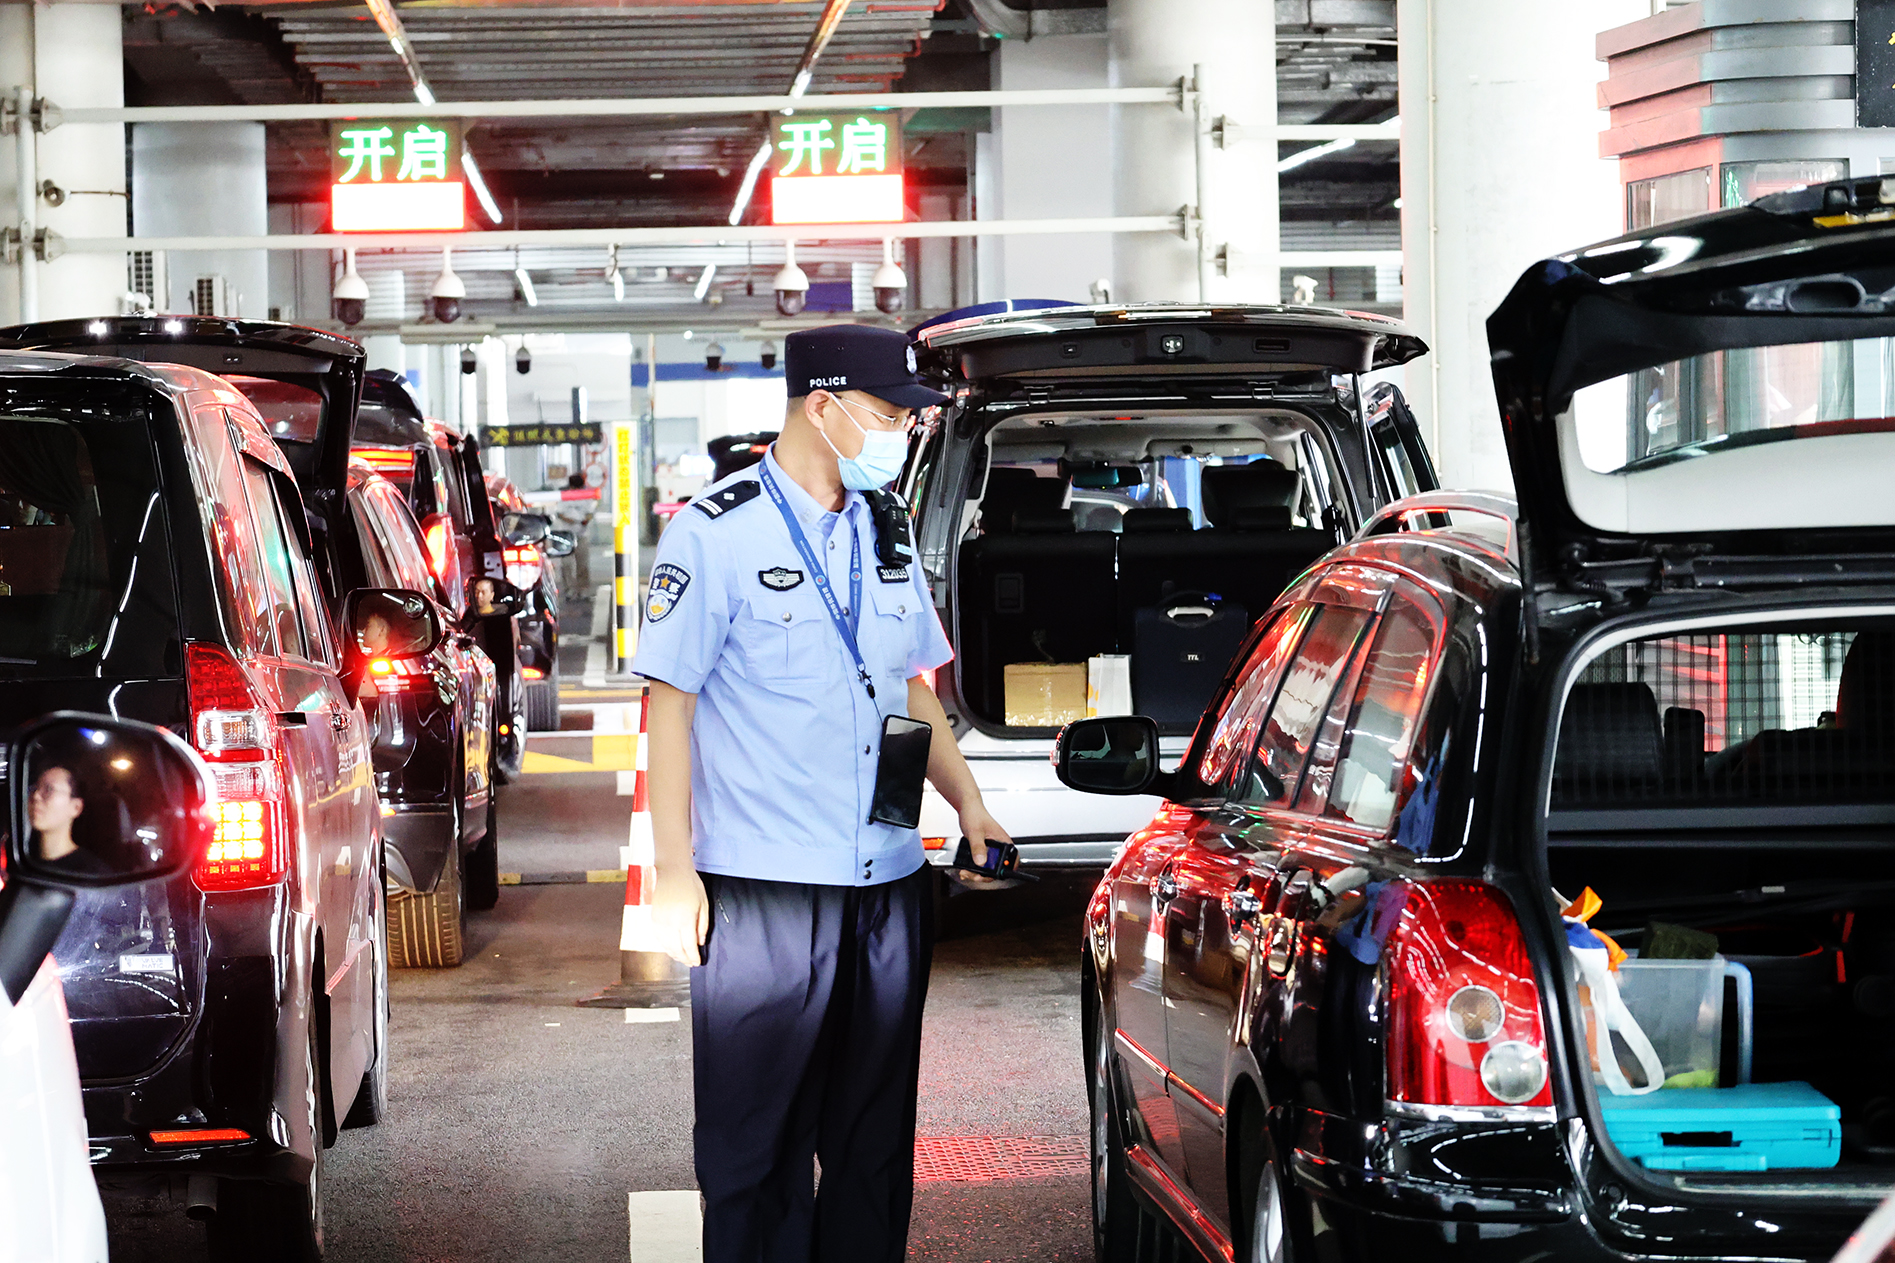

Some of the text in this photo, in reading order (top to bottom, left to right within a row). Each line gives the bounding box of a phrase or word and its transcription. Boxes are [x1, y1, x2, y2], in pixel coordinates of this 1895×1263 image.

[338, 124, 447, 183] 开启
[778, 117, 886, 176] 开启
[809, 376, 847, 388] POLICE
